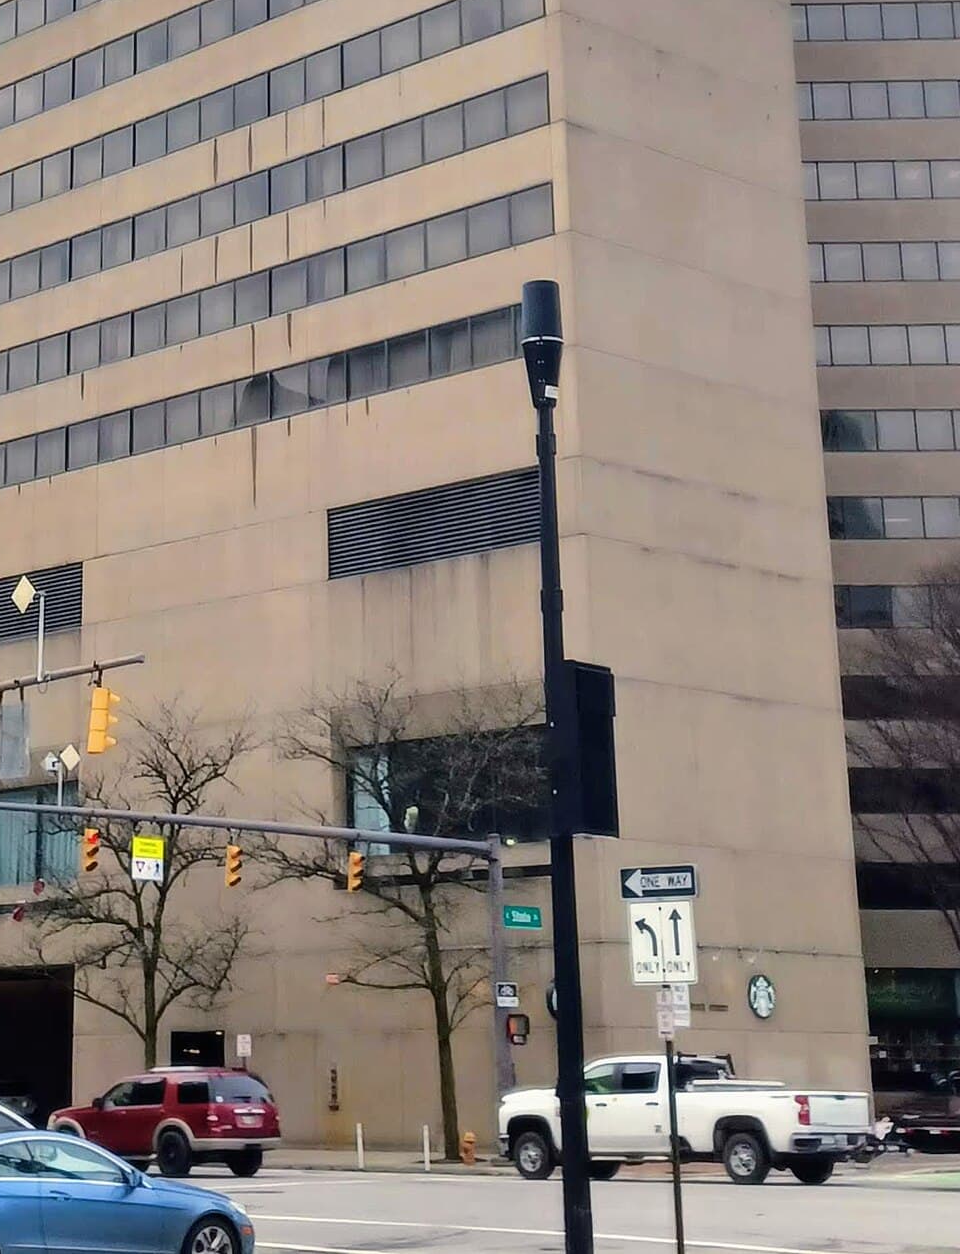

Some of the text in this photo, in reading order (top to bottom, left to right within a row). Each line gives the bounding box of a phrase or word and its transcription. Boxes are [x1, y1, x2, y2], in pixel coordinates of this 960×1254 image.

[640, 874, 688, 888] ONE WAY
[636, 961, 660, 974] ONLY
[667, 960, 691, 973] ONLY
